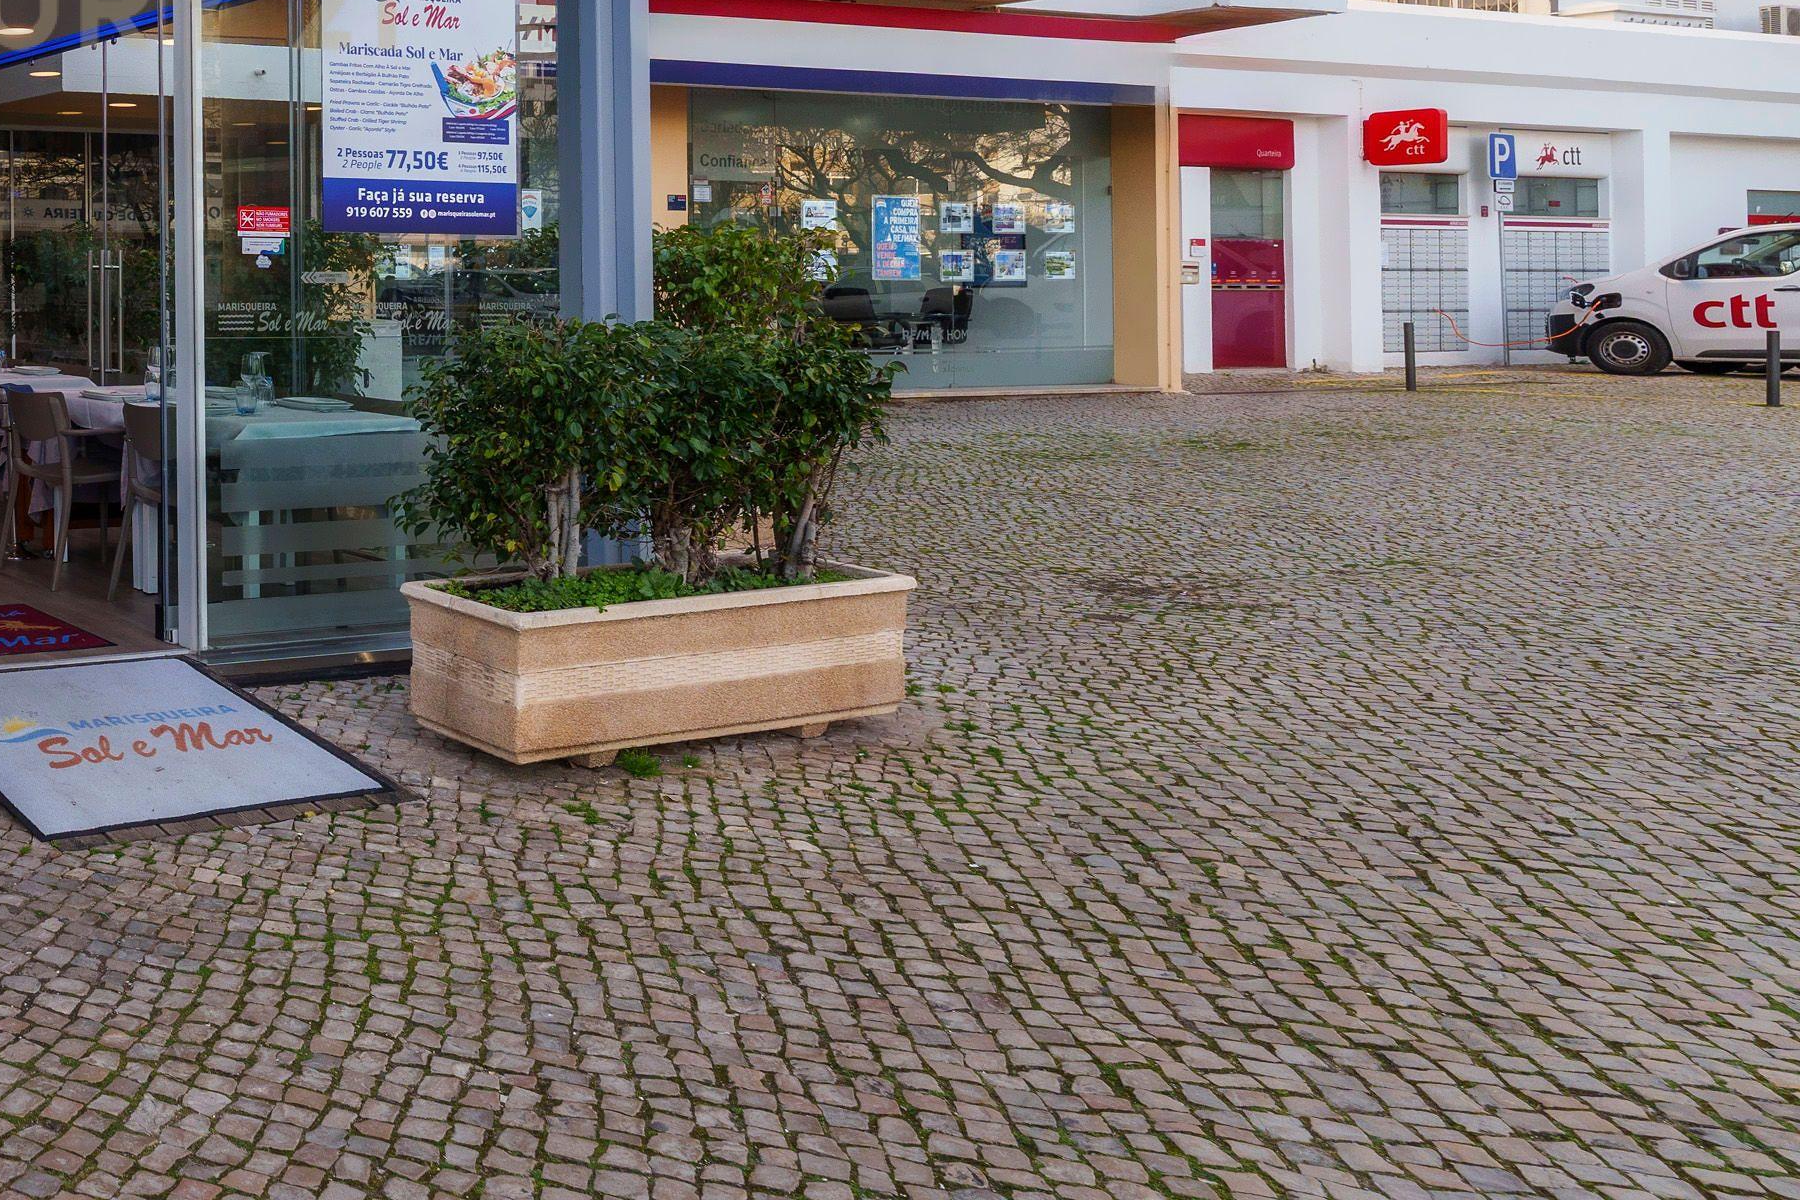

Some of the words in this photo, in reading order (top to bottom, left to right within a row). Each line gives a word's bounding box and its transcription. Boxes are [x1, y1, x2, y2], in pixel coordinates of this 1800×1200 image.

[381, 2, 410, 27] Sol
[411, 13, 420, 27] e
[423, 4, 460, 30] Mar
[339, 41, 405, 59] Mariscada
[406, 45, 425, 60] Sol
[428, 50, 436, 60] e
[439, 48, 464, 62] Mar
[337, 147, 343, 157] 2
[345, 147, 384, 159] Pessoas
[477, 151, 504, 162] 97,50€
[1256, 148, 1282, 158] Quarteira
[1406, 144, 1425, 156] ctt
[1494, 137, 1511, 175] P
[1563, 146, 1582, 166] ctt
[342, 159, 348, 169] 2
[350, 159, 383, 172] People
[385, 149, 449, 173] 77,50€
[477, 164, 508, 175] 115,50€
[358, 187, 389, 205] Faça
[392, 187, 405, 205] já
[409, 191, 432, 203] sua
[436, 192, 485, 204] reserva
[346, 206, 367, 218] 919
[369, 207, 390, 218] 607
[392, 207, 413, 219] 559
[437, 210, 496, 219] marisqueirasolemar.pt
[893, 207, 919, 216] COMPRA
[890, 216, 919, 225] PRIMEIRA
[890, 225, 907, 234] CASA
[217, 302, 277, 313] MARISQUEIRA
[479, 302, 532, 311] MARISQUEIRA
[1692, 293, 1778, 329] ctt
[257, 311, 282, 332] Sol
[296, 310, 329, 332] Mar
[66, 704, 240, 732] MARISQUEIRA
[36, 735, 125, 770] Sol
[131, 739, 157, 758] e
[149, 721, 273, 753] Mar
